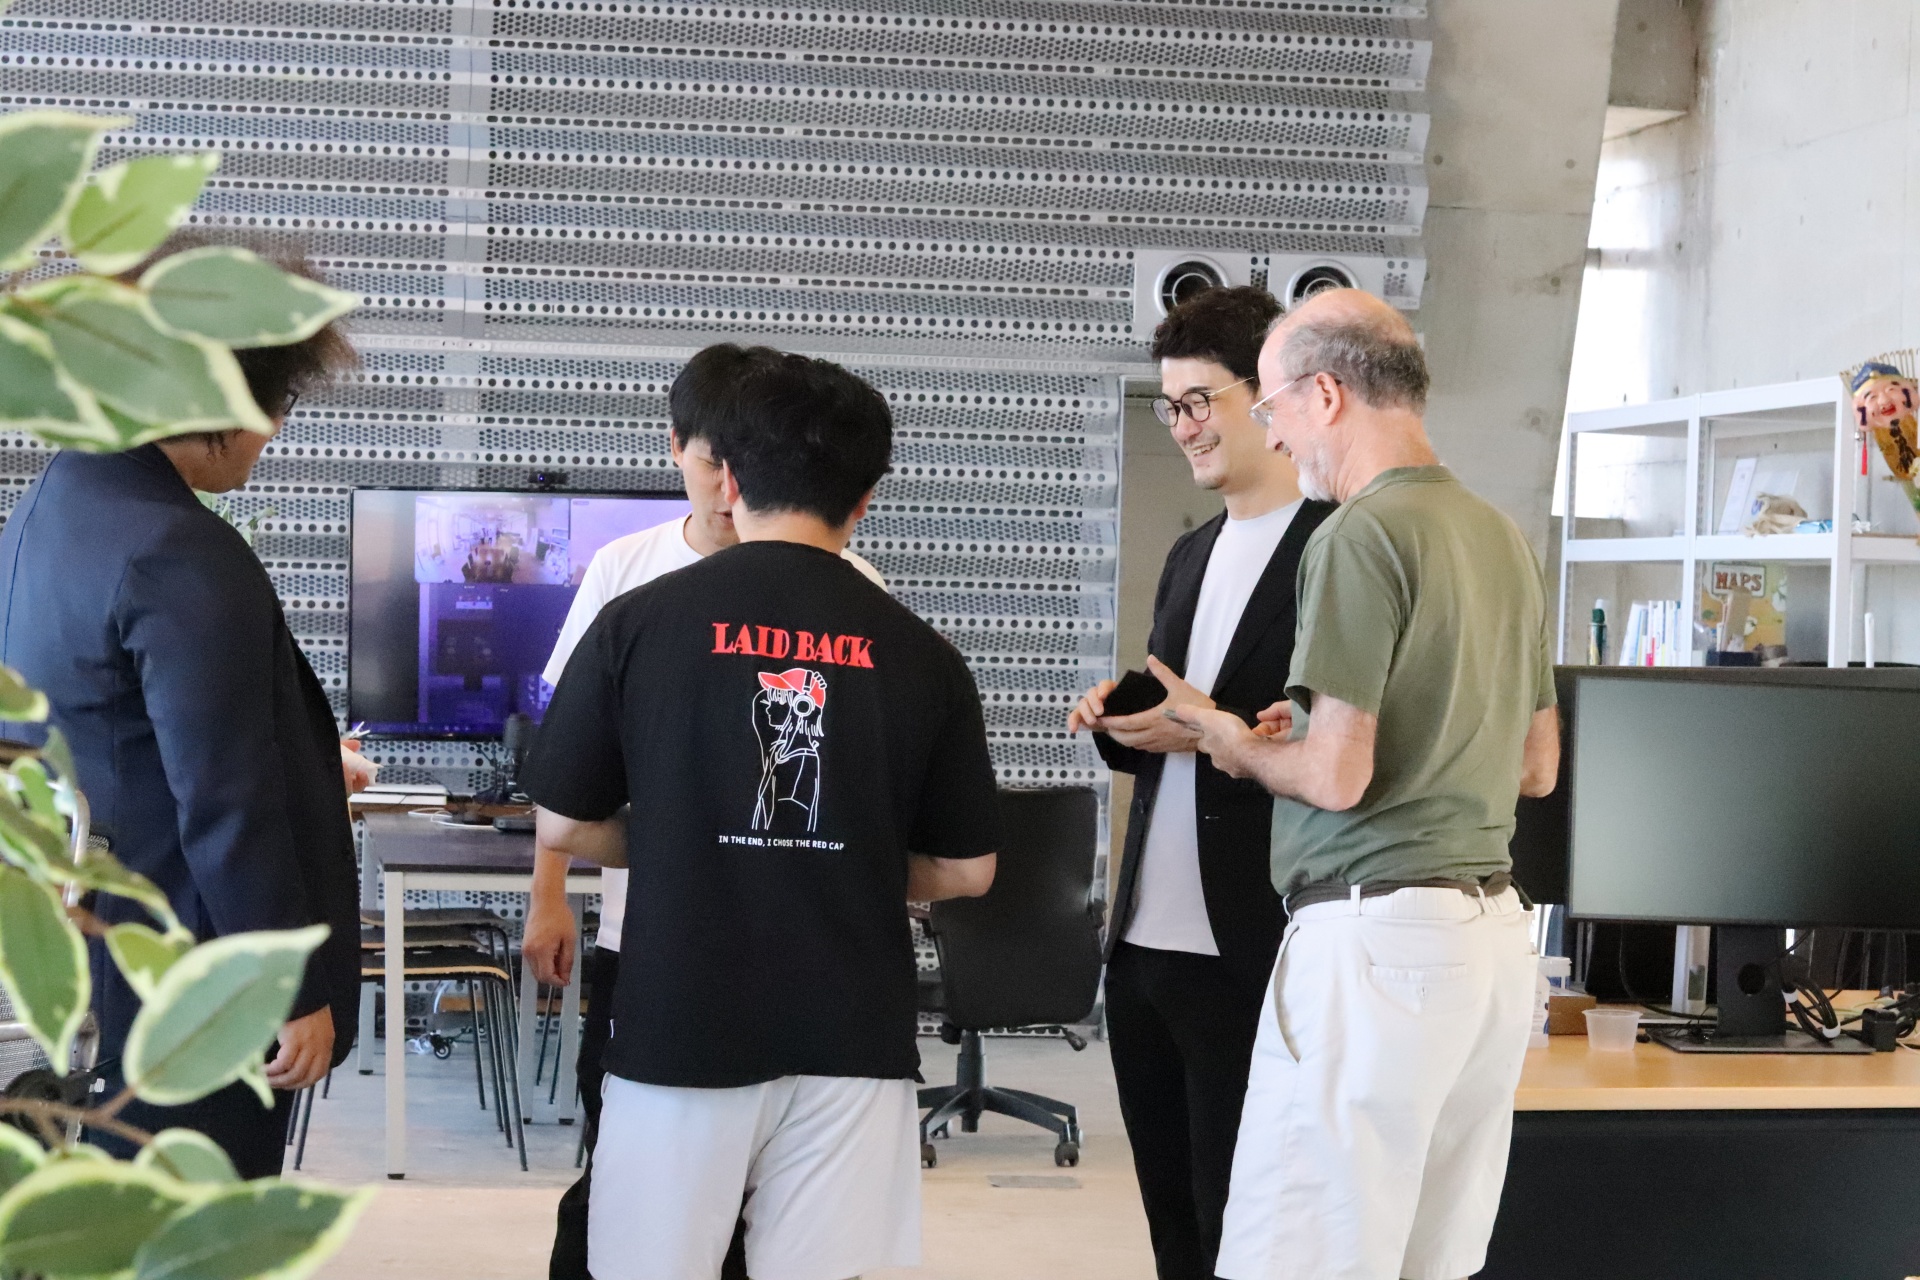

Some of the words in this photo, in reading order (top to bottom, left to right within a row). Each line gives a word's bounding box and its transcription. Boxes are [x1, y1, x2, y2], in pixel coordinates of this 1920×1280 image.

[1715, 571, 1763, 592] MAPS
[711, 622, 791, 659] LAID
[793, 630, 875, 669] BACK
[718, 835, 729, 844] IN
[731, 835, 746, 845] THE
[747, 836, 766, 847] END,
[767, 838, 772, 847] I
[773, 838, 794, 848] CHOSE
[795, 839, 811, 848] THE
[812, 840, 827, 849] RED
[828, 842, 845, 851] CAP
